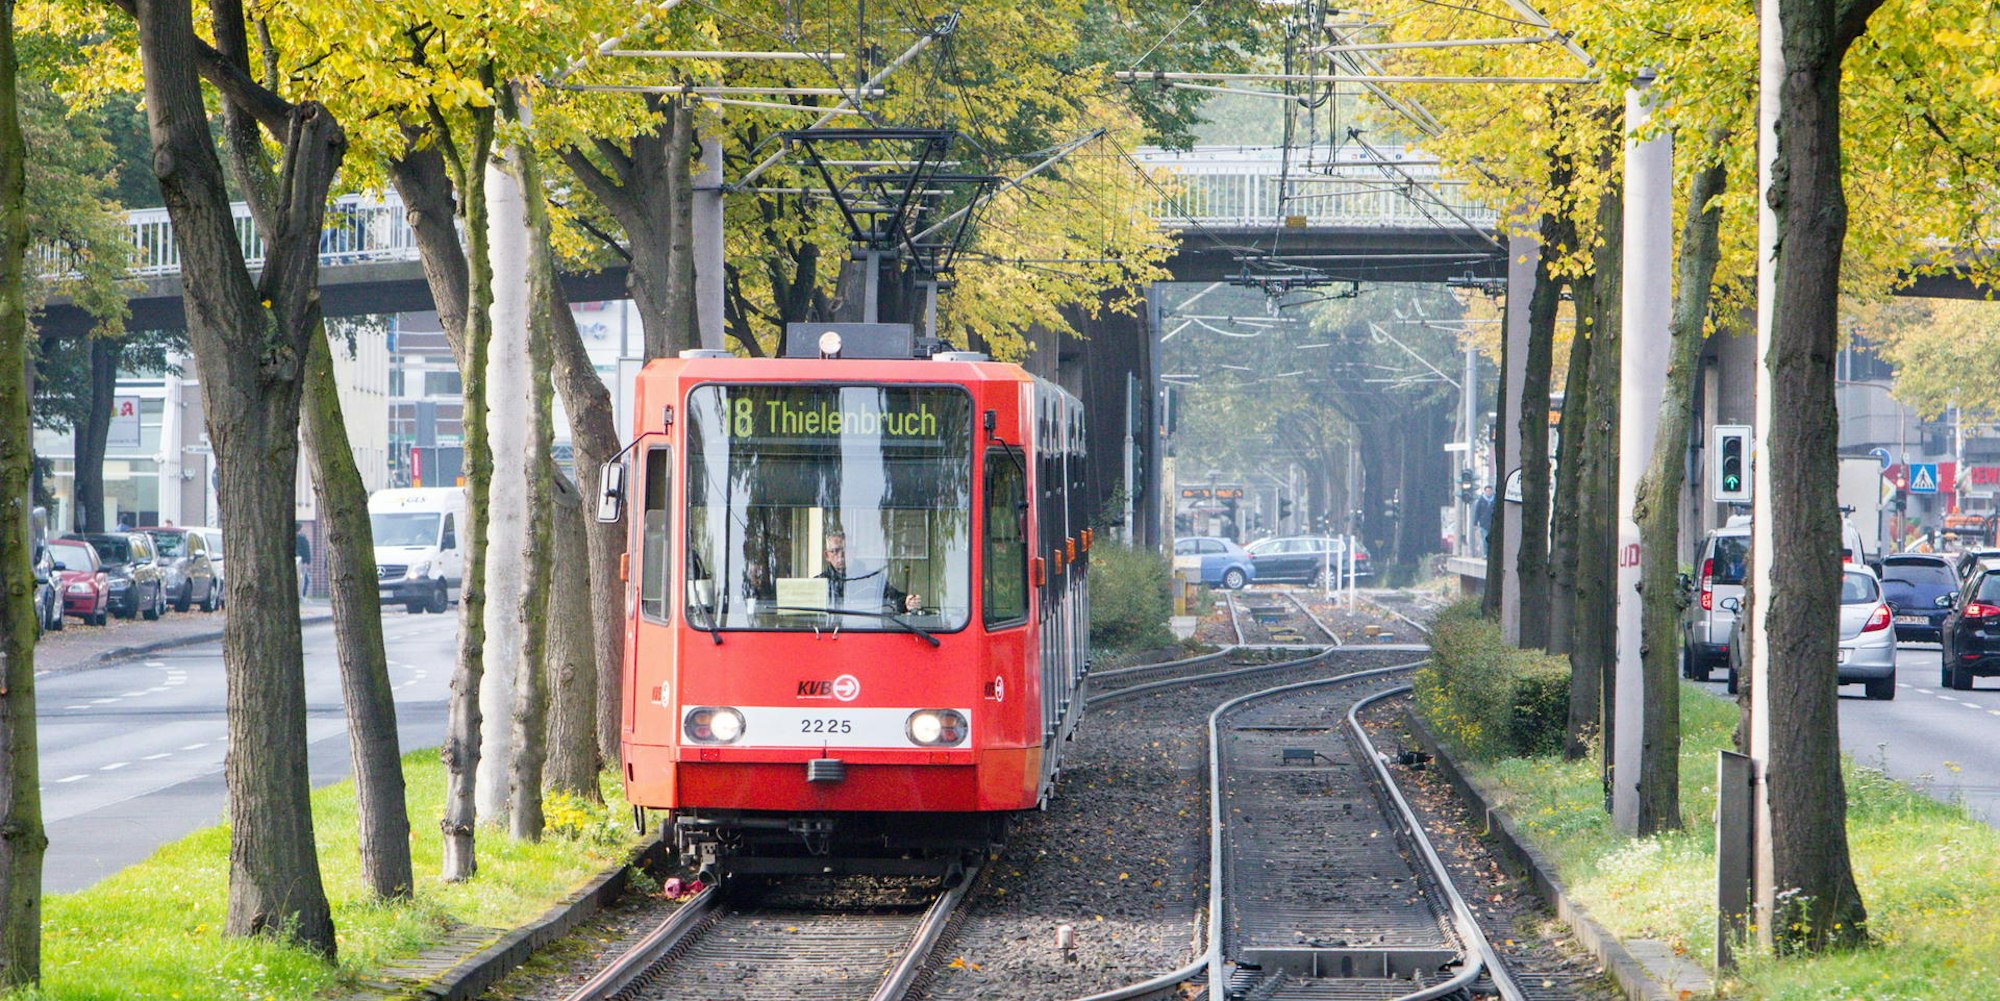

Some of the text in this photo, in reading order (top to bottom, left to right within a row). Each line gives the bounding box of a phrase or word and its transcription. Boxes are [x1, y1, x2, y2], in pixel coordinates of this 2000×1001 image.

[725, 397, 937, 438] 18 Thielenbruch
[797, 680, 832, 696] KVB
[801, 719, 852, 733] 2225
